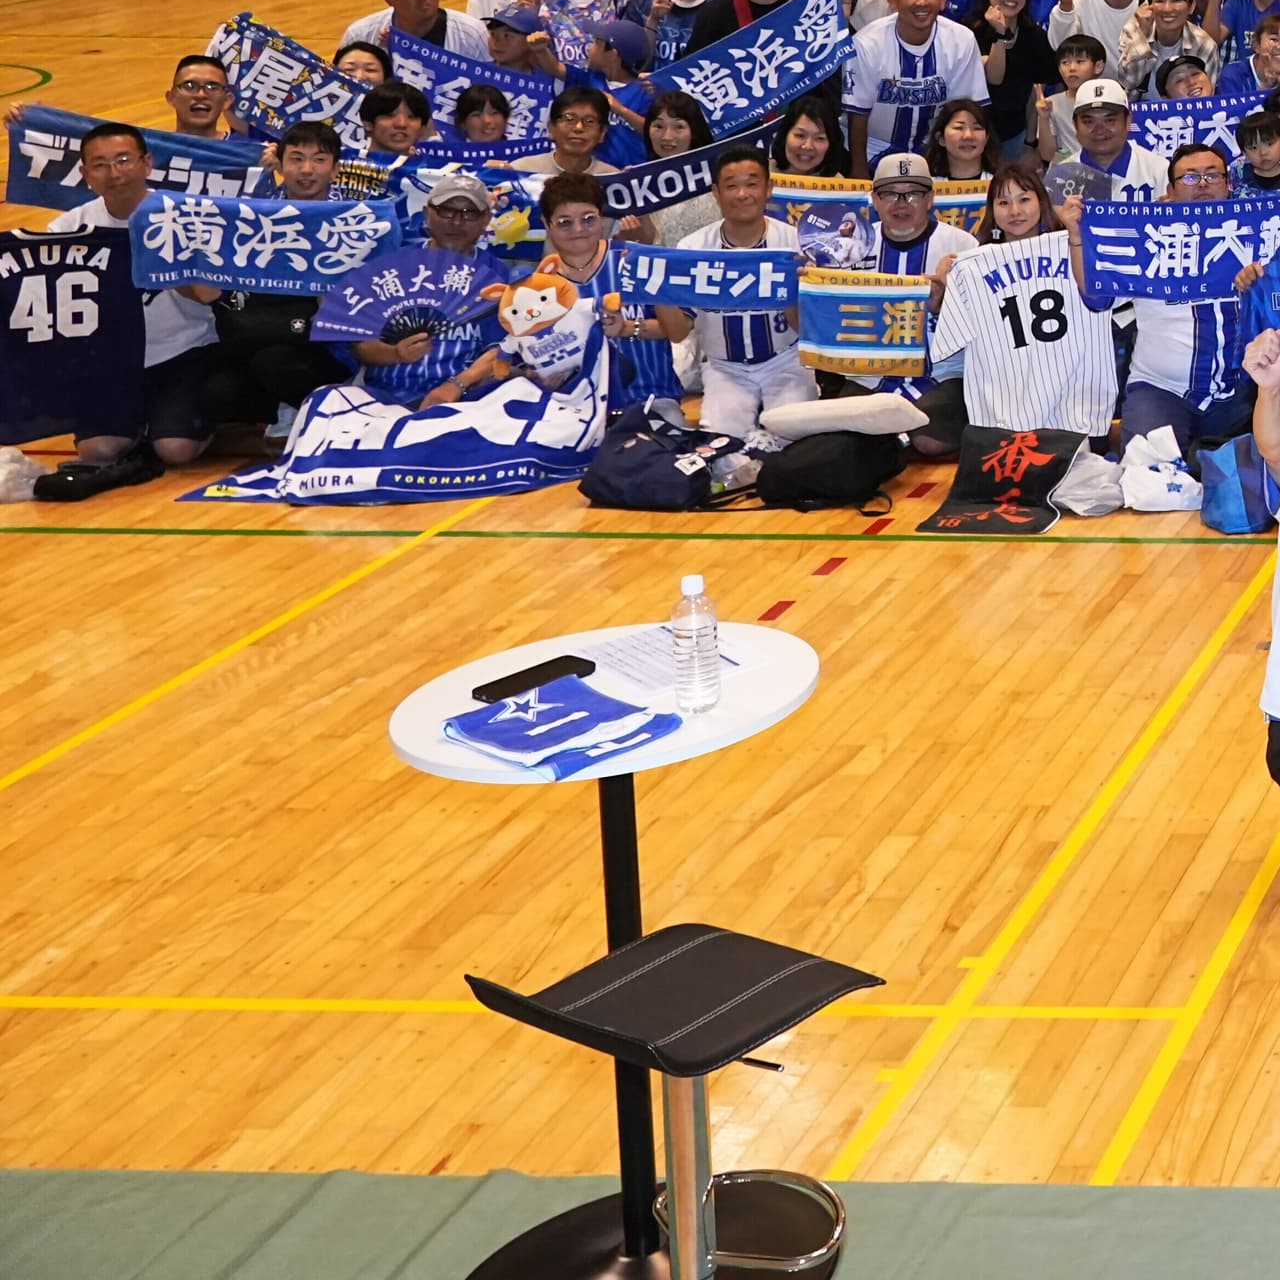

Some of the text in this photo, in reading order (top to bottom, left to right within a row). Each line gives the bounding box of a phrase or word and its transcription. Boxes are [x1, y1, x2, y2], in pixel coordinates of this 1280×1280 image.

[394, 35, 511, 83] YOKOHAMA DeNA
[1175, 98, 1213, 109] DeNA
[1086, 204, 1173, 216] YOKOHAMA
[1182, 203, 1225, 216] DeNA
[143, 194, 392, 274] 横浜愛
[0, 244, 112, 281] MIURA
[150, 268, 302, 290] THE REASON TO FIGHT
[636, 257, 786, 299] リーゼント
[820, 273, 904, 286] YOKOHAMA
[981, 257, 1069, 294] MIURA
[343, 264, 476, 317] 三浦大輔
[1095, 280, 1207, 295] DAISUKE
[9, 270, 100, 343] 46
[835, 299, 926, 346] 三浦
[999, 289, 1068, 351] 18
[298, 472, 487, 491] MIURA YOKOHAMA
